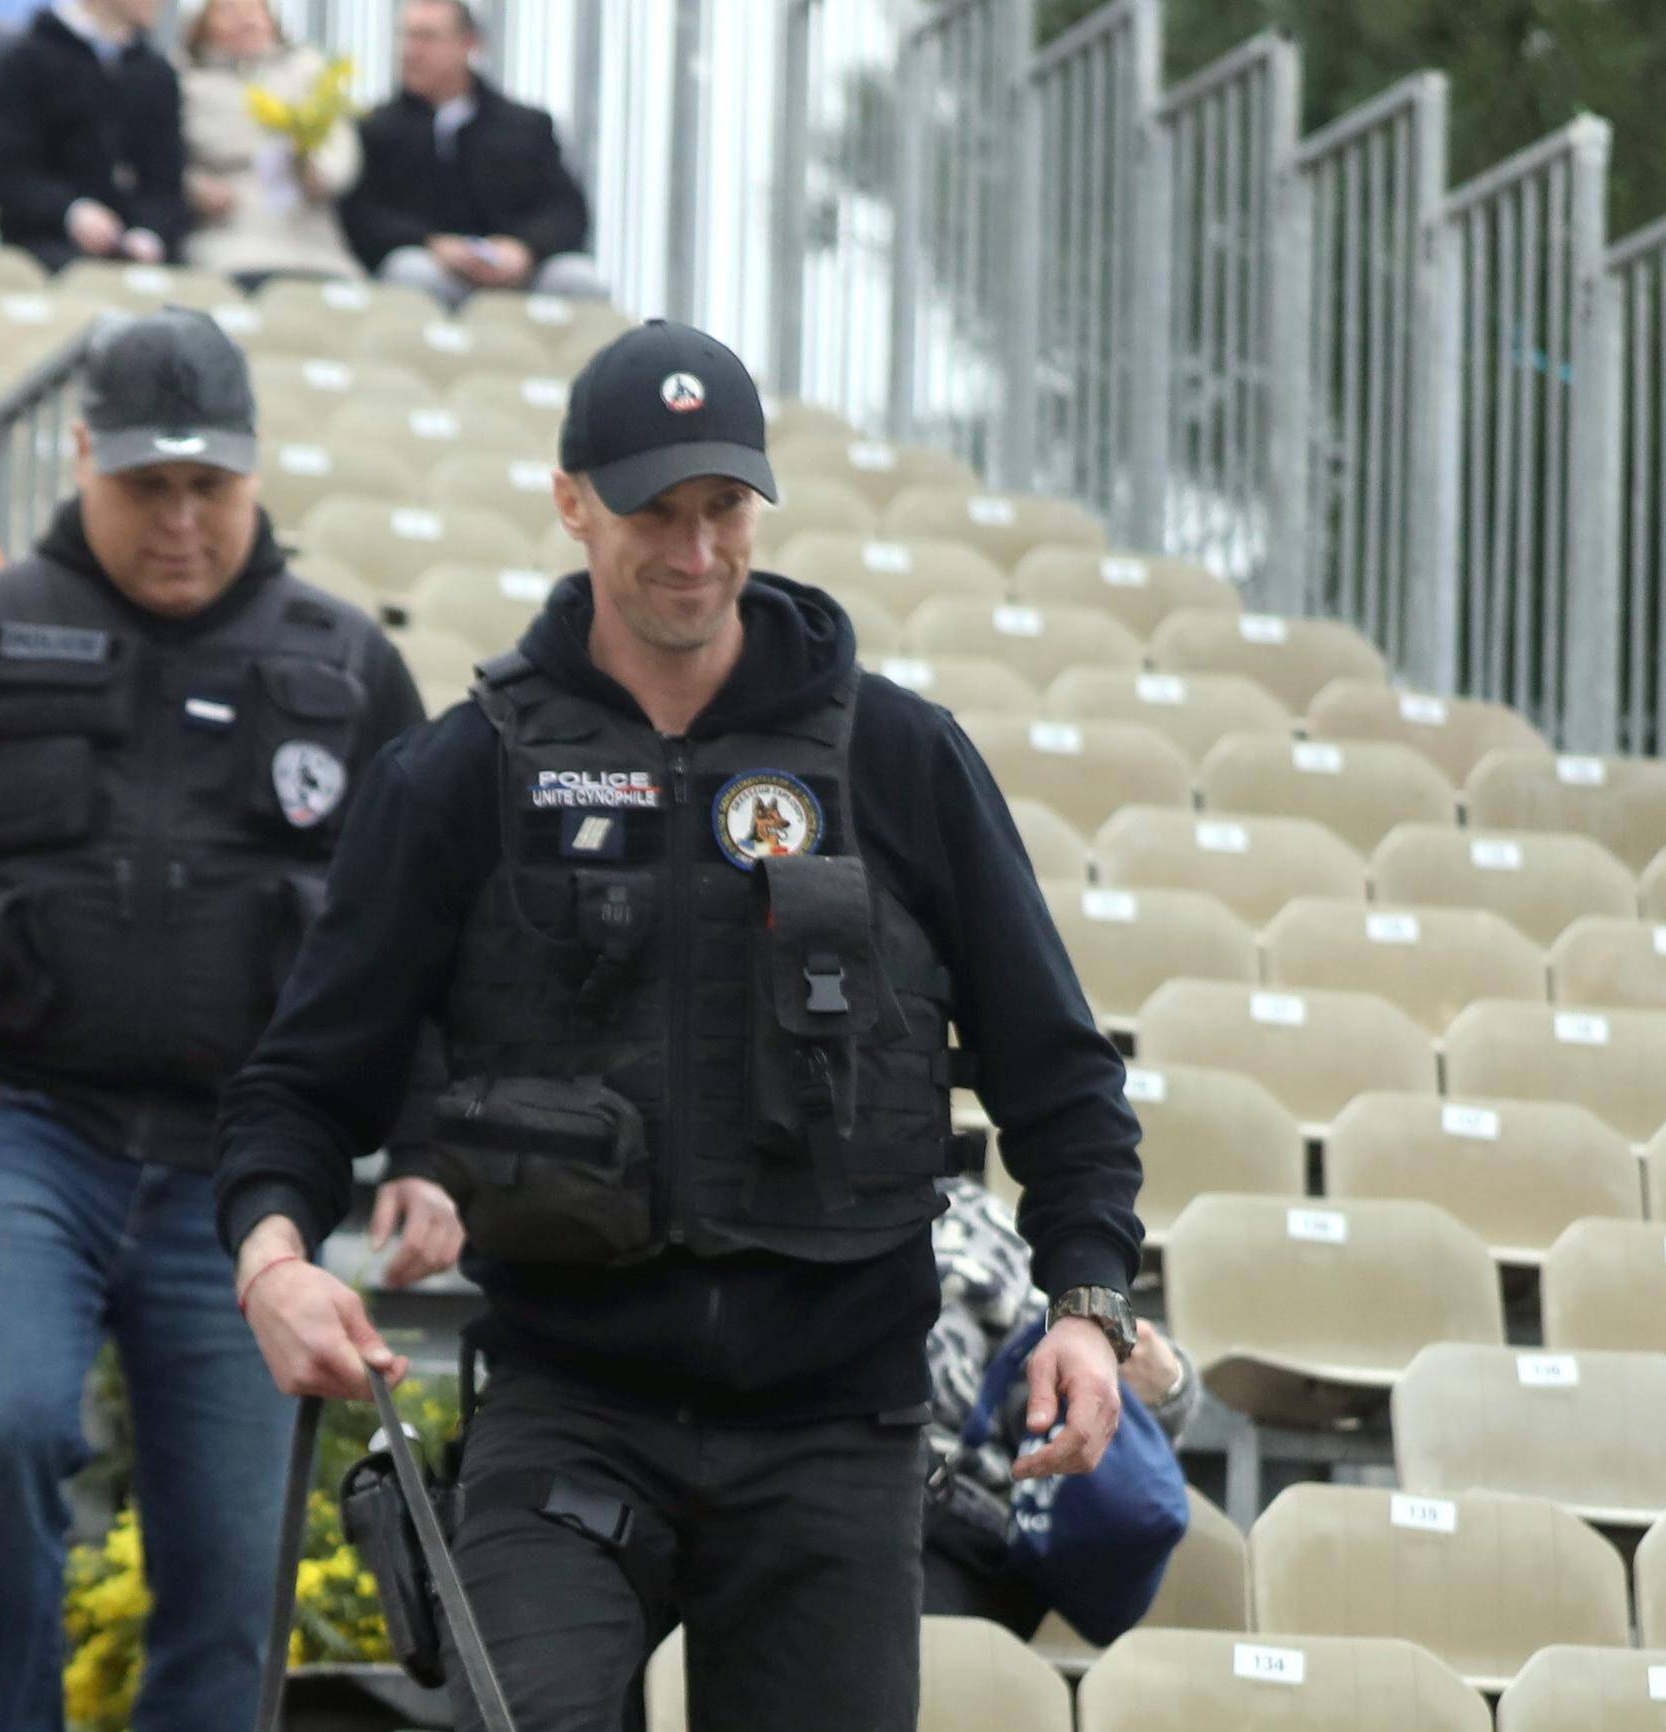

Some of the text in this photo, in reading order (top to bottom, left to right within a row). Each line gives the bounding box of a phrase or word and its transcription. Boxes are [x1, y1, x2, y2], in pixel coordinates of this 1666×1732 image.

[538, 770, 650, 788] POLICE
[576, 788, 657, 807] CYNOPHILE
[1254, 1654, 1284, 1672] 134
